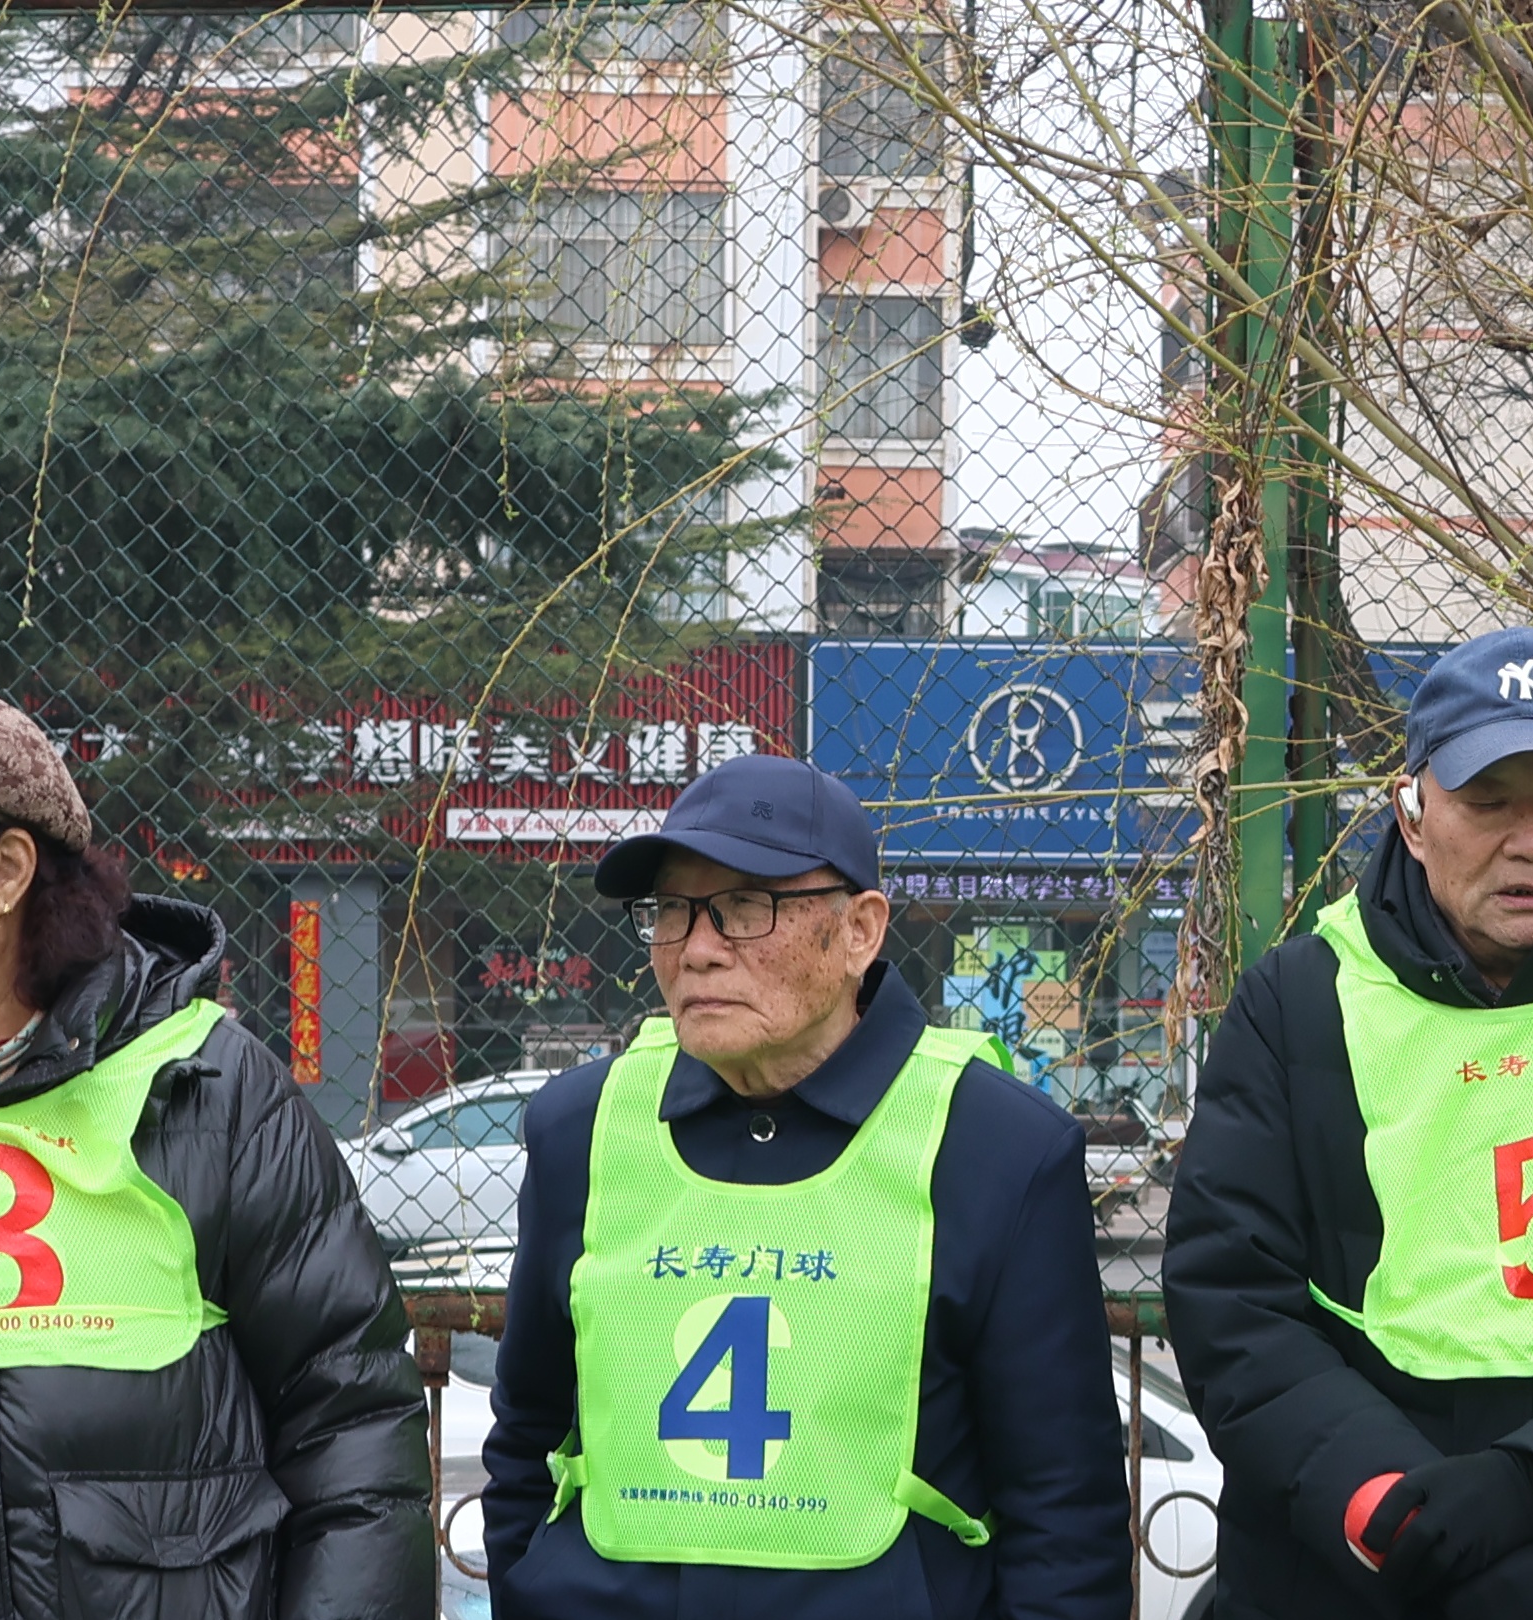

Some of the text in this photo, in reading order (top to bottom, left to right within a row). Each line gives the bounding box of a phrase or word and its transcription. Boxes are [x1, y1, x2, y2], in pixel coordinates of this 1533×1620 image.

[934, 805, 1118, 821] TREASURE EYES
[646, 1244, 838, 1282] 长寿门球
[658, 1296, 792, 1480] 4
[708, 1490, 828, 1514] 400-0340-999
